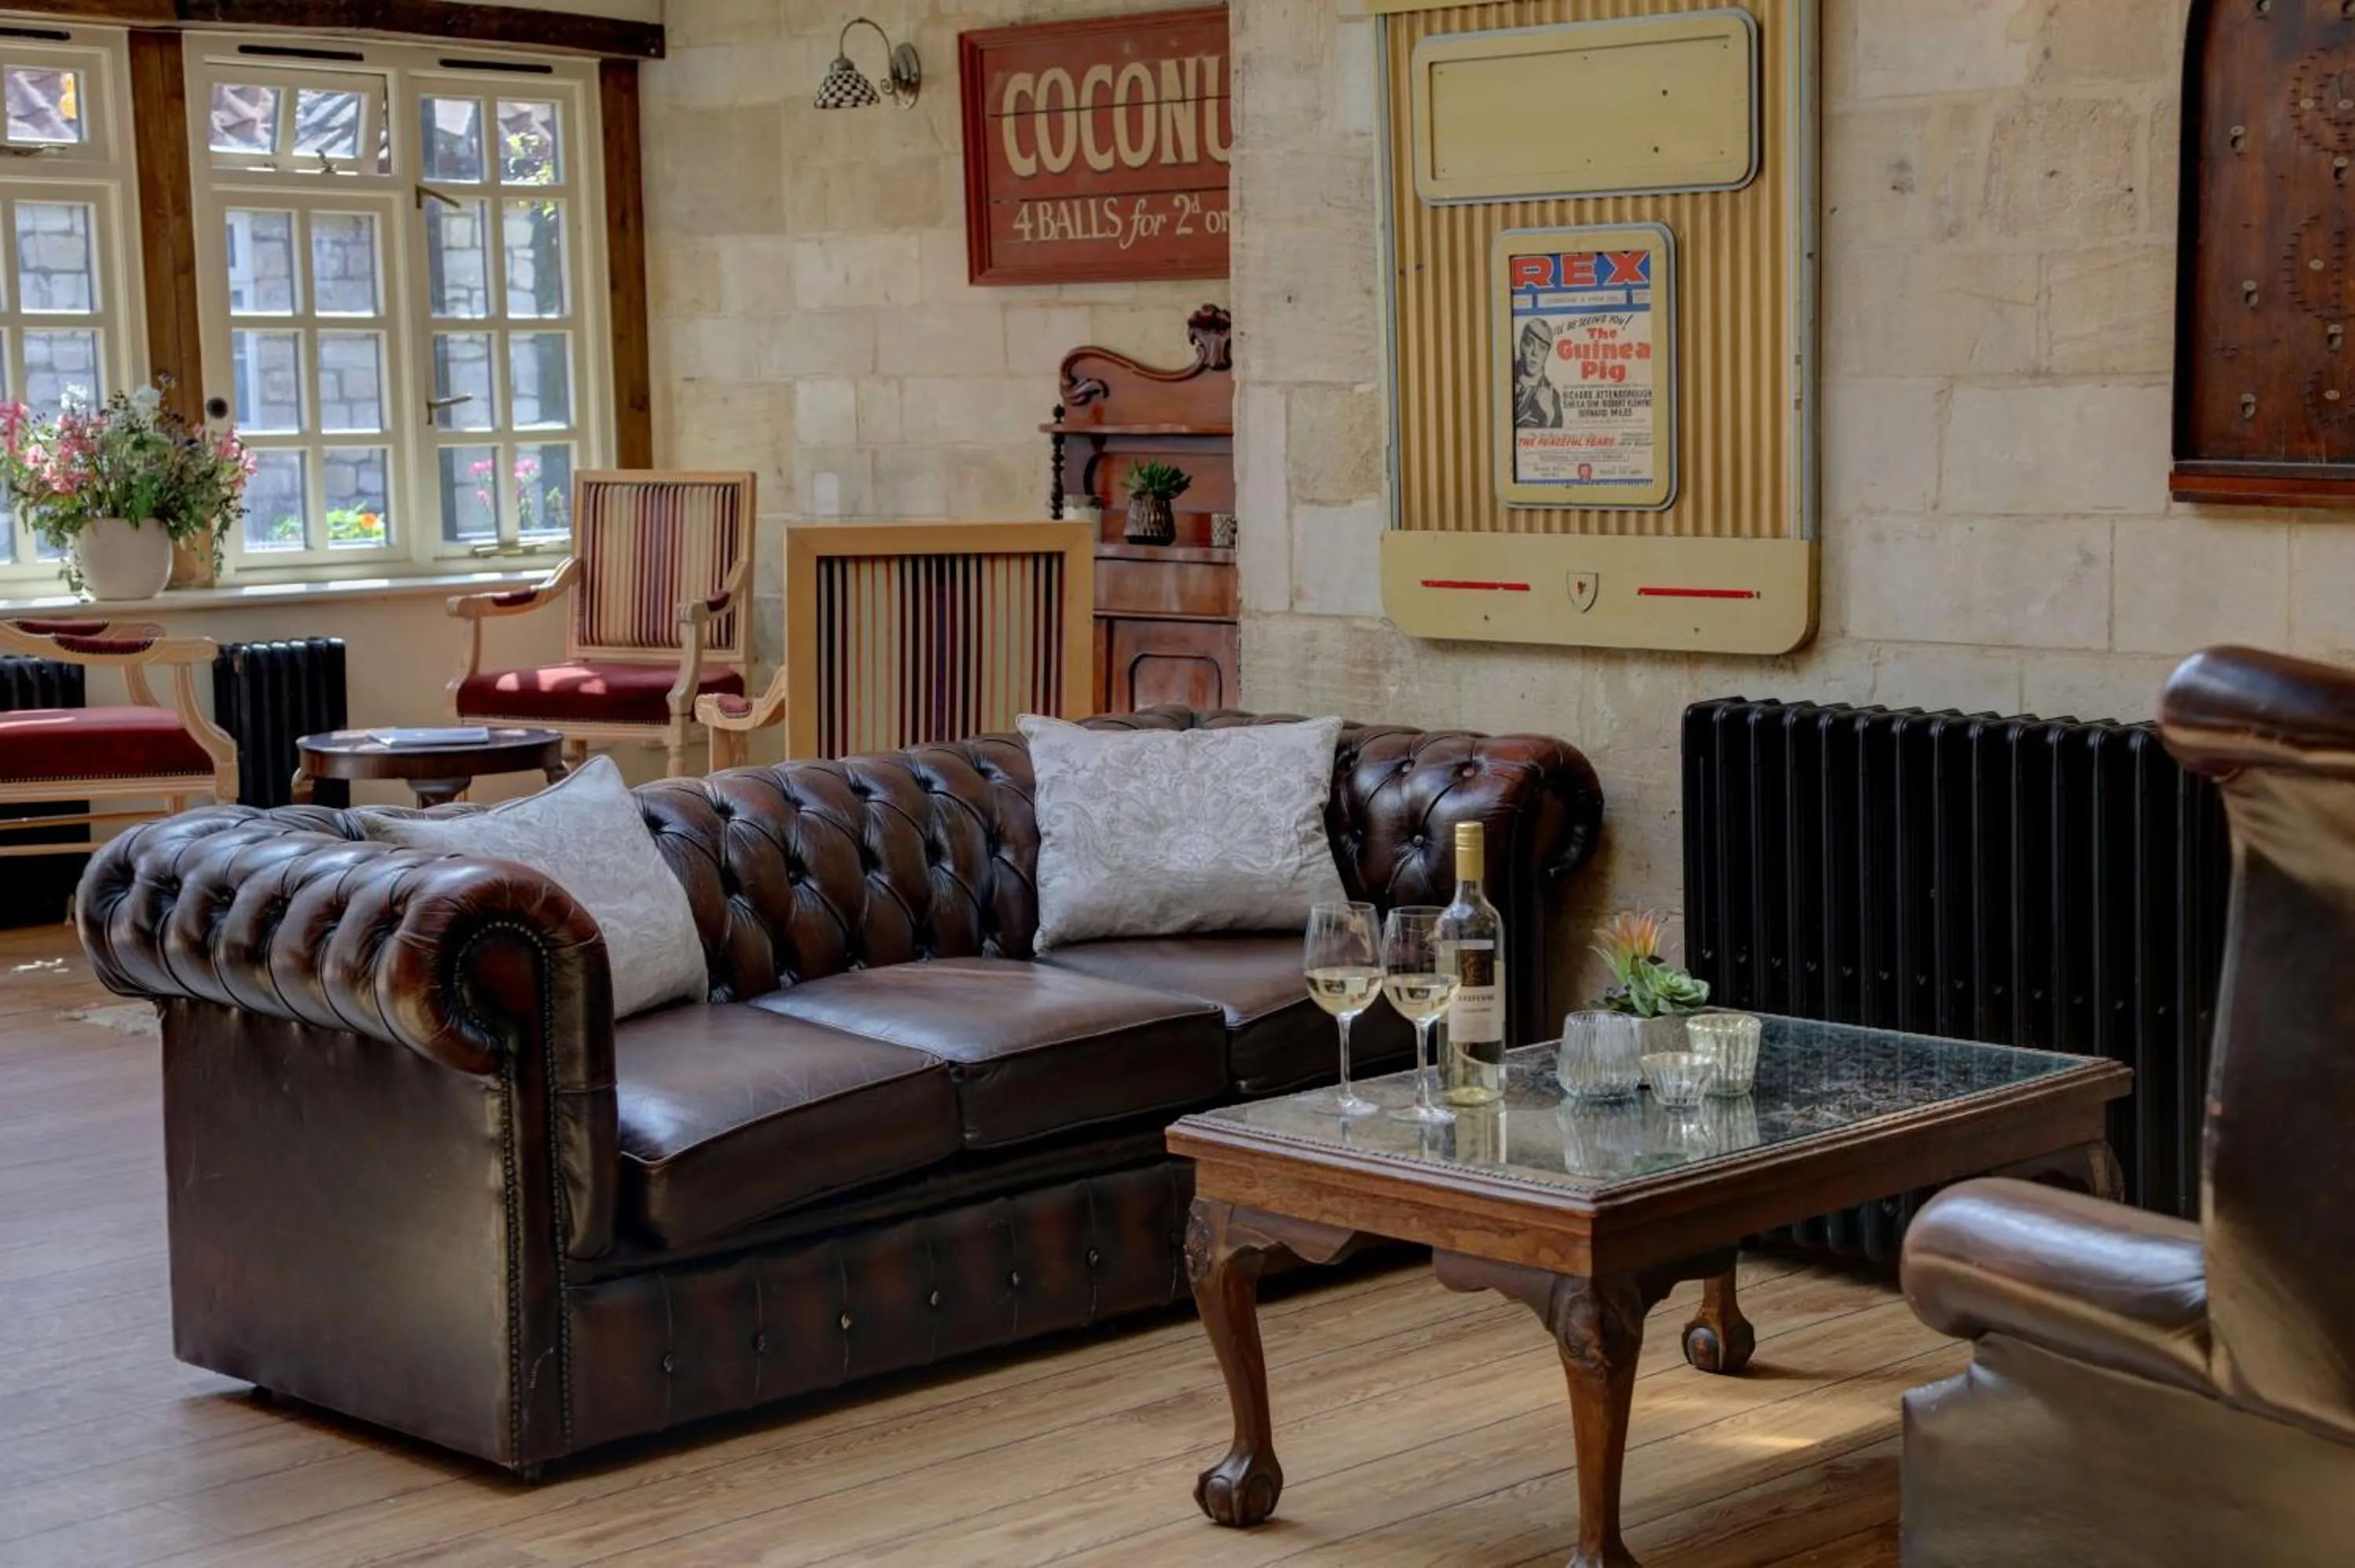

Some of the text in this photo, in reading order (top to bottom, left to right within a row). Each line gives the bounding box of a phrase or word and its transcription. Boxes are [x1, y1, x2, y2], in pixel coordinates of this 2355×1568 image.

[1002, 56, 1232, 177] COCONU
[1013, 202, 1033, 242] 4
[1037, 197, 1123, 242] BALLS
[1119, 199, 1167, 250] for
[1512, 250, 1649, 289] REX
[1586, 327, 1618, 339] The
[1557, 339, 1651, 360] Guinea
[1581, 361, 1627, 383] Pig
